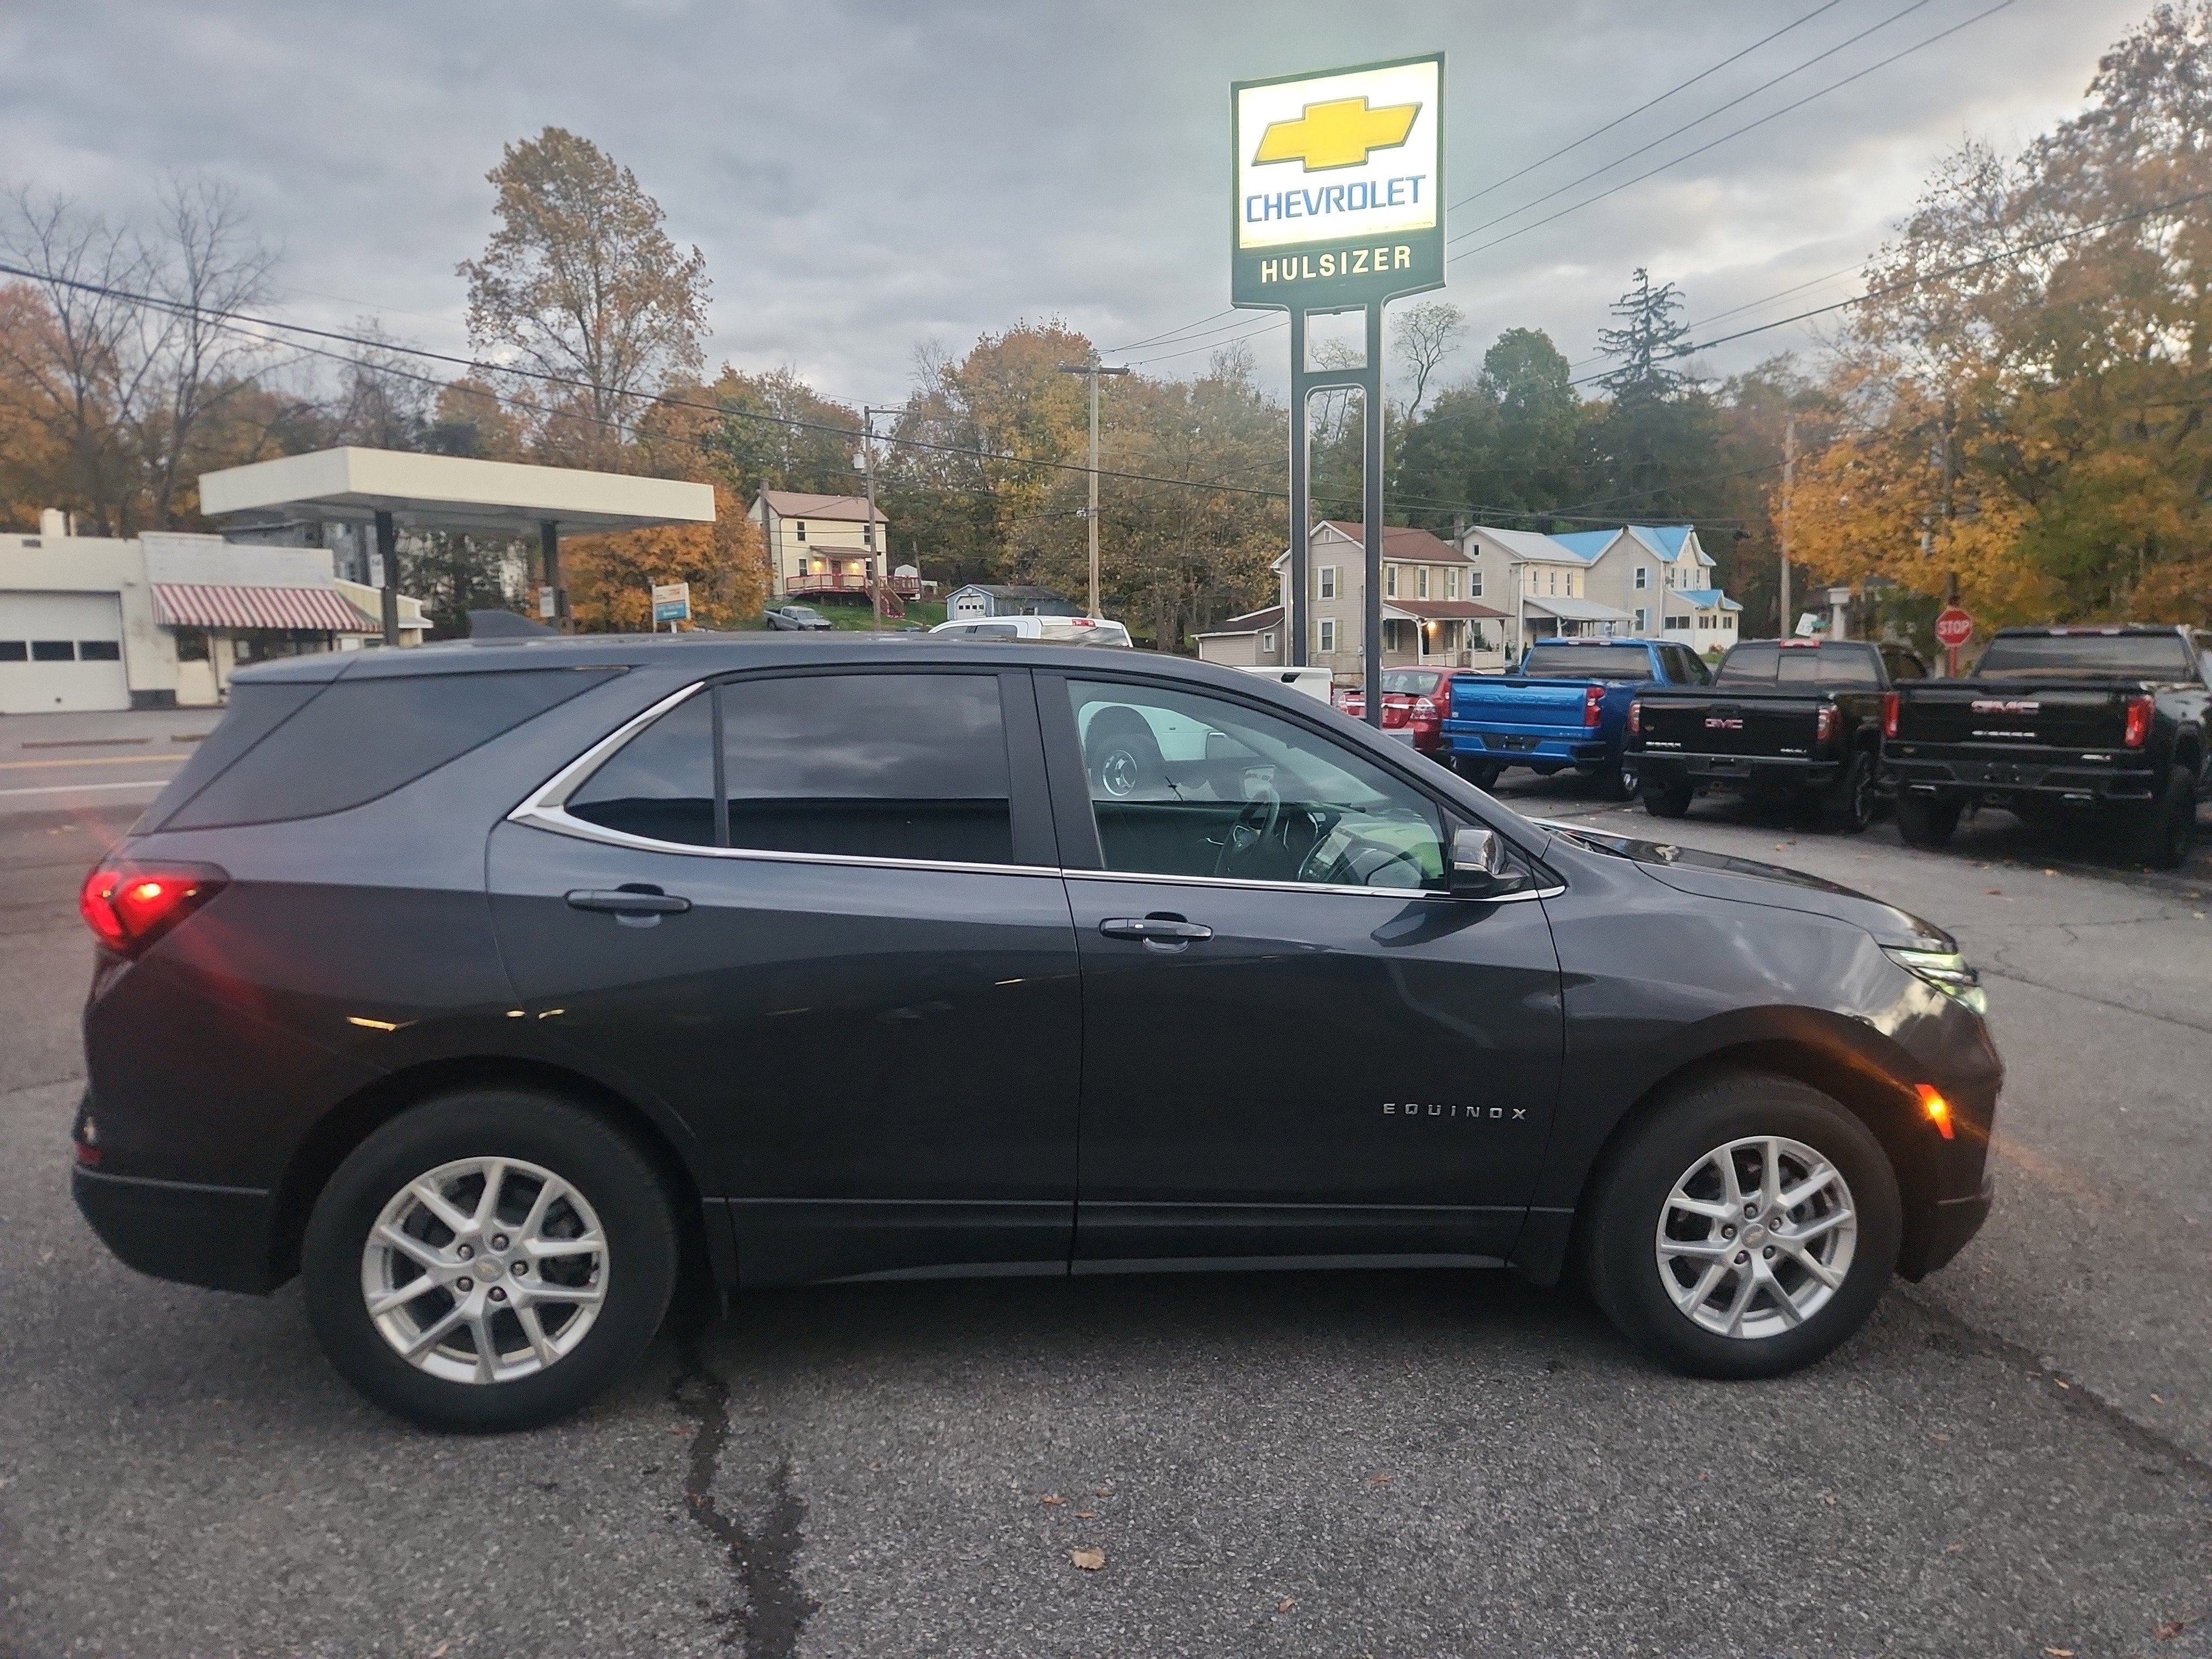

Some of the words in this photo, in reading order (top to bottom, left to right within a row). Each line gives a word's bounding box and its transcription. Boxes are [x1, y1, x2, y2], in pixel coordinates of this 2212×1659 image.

[1246, 174, 1426, 222] CHEVROLET
[1261, 245, 1411, 284] HULSIZER
[1938, 620, 1970, 635] STOP
[1971, 700, 2039, 714] GMC
[1705, 718, 1743, 729] GMC
[1383, 1103, 1526, 1120] EQUINOX
